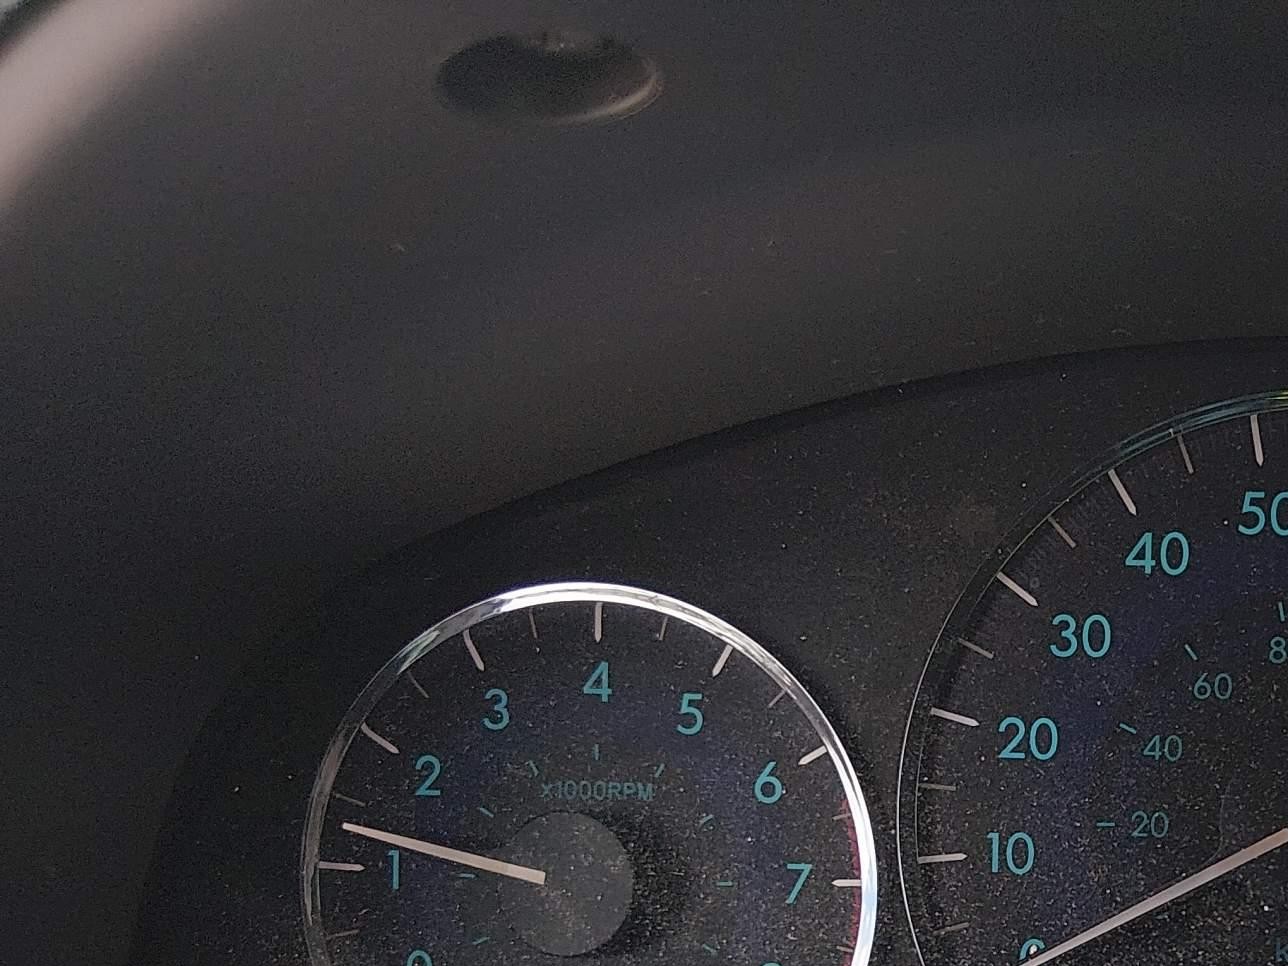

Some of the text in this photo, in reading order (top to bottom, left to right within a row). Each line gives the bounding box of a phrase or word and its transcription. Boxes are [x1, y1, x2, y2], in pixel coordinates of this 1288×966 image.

[1124, 531, 1190, 576] 40
[1049, 613, 1112, 658] 30
[583, 660, 612, 703] 4
[1193, 672, 1233, 700] 60
[480, 688, 509, 731] 3
[676, 691, 704, 736] 5
[998, 716, 1059, 761] 20
[1142, 735, 1184, 763] 40
[415, 755, 442, 796] 2
[754, 761, 784, 804] 6
[1131, 810, 1169, 839] 20
[387, 849, 400, 890] 1
[986, 832, 1035, 875] 10
[785, 863, 812, 904] 7
